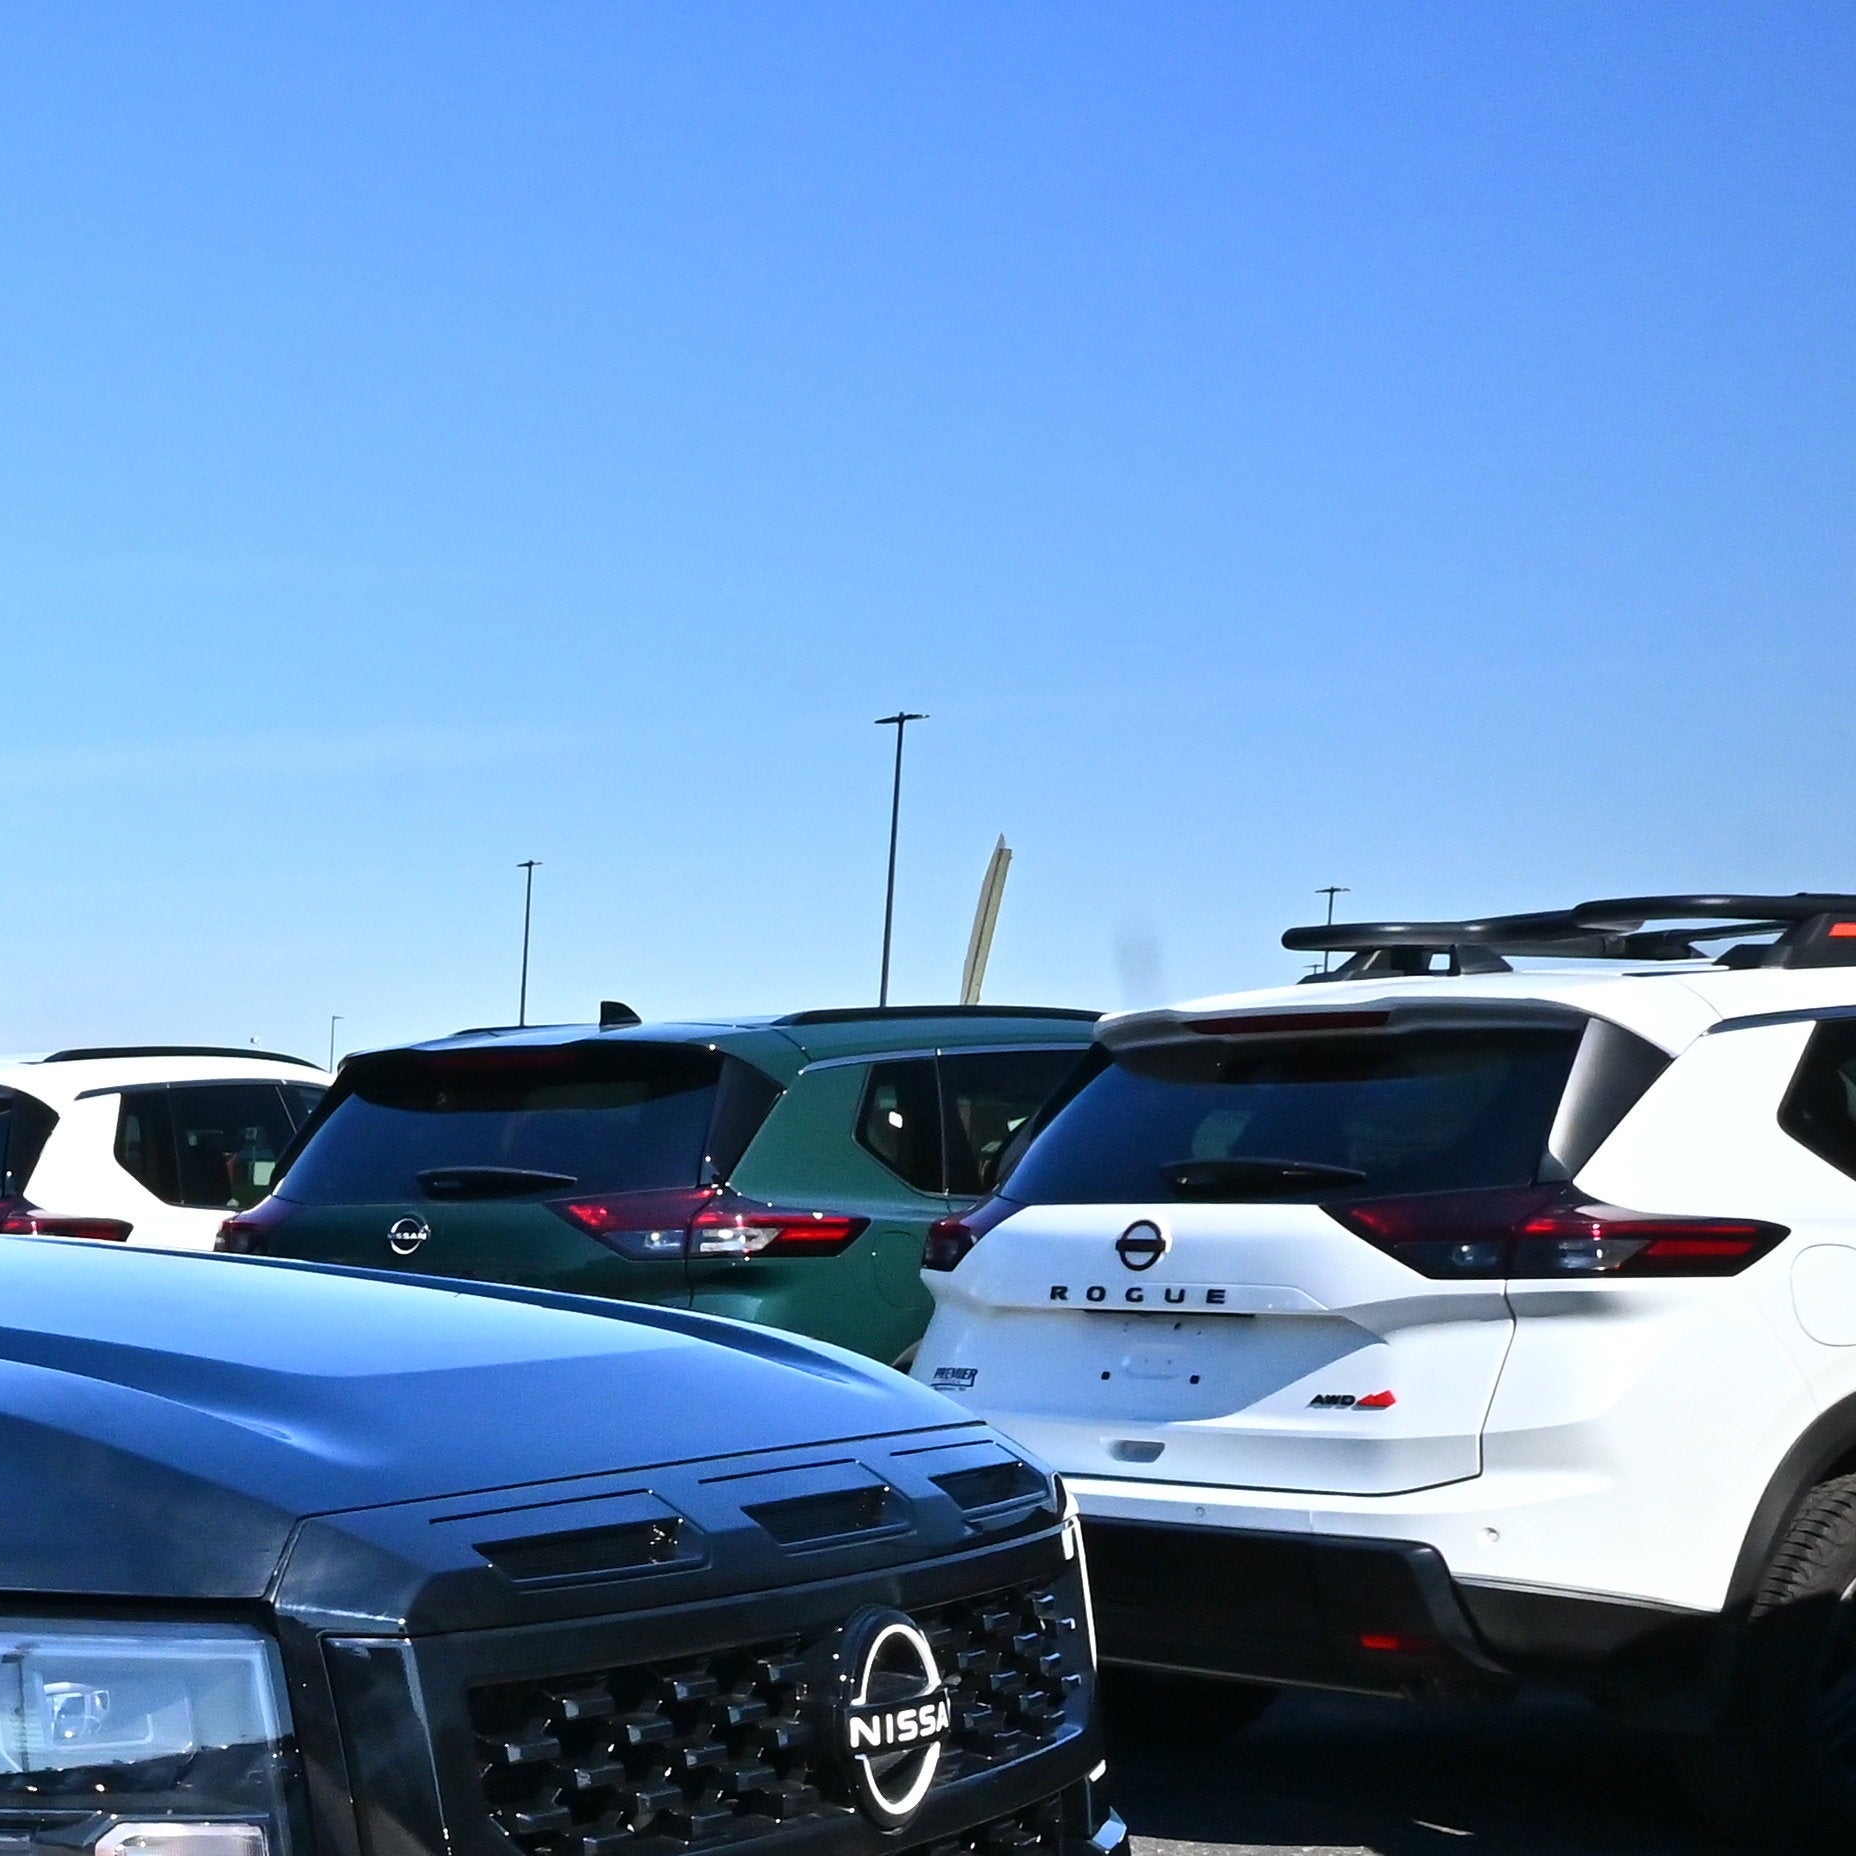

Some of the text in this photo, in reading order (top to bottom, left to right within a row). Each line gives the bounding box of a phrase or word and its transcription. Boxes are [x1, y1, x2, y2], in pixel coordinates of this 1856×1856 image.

[1050, 1285, 1226, 1304] ROGUE
[1309, 1394, 1356, 1406] AWD
[849, 1701, 950, 1749] NISSA
